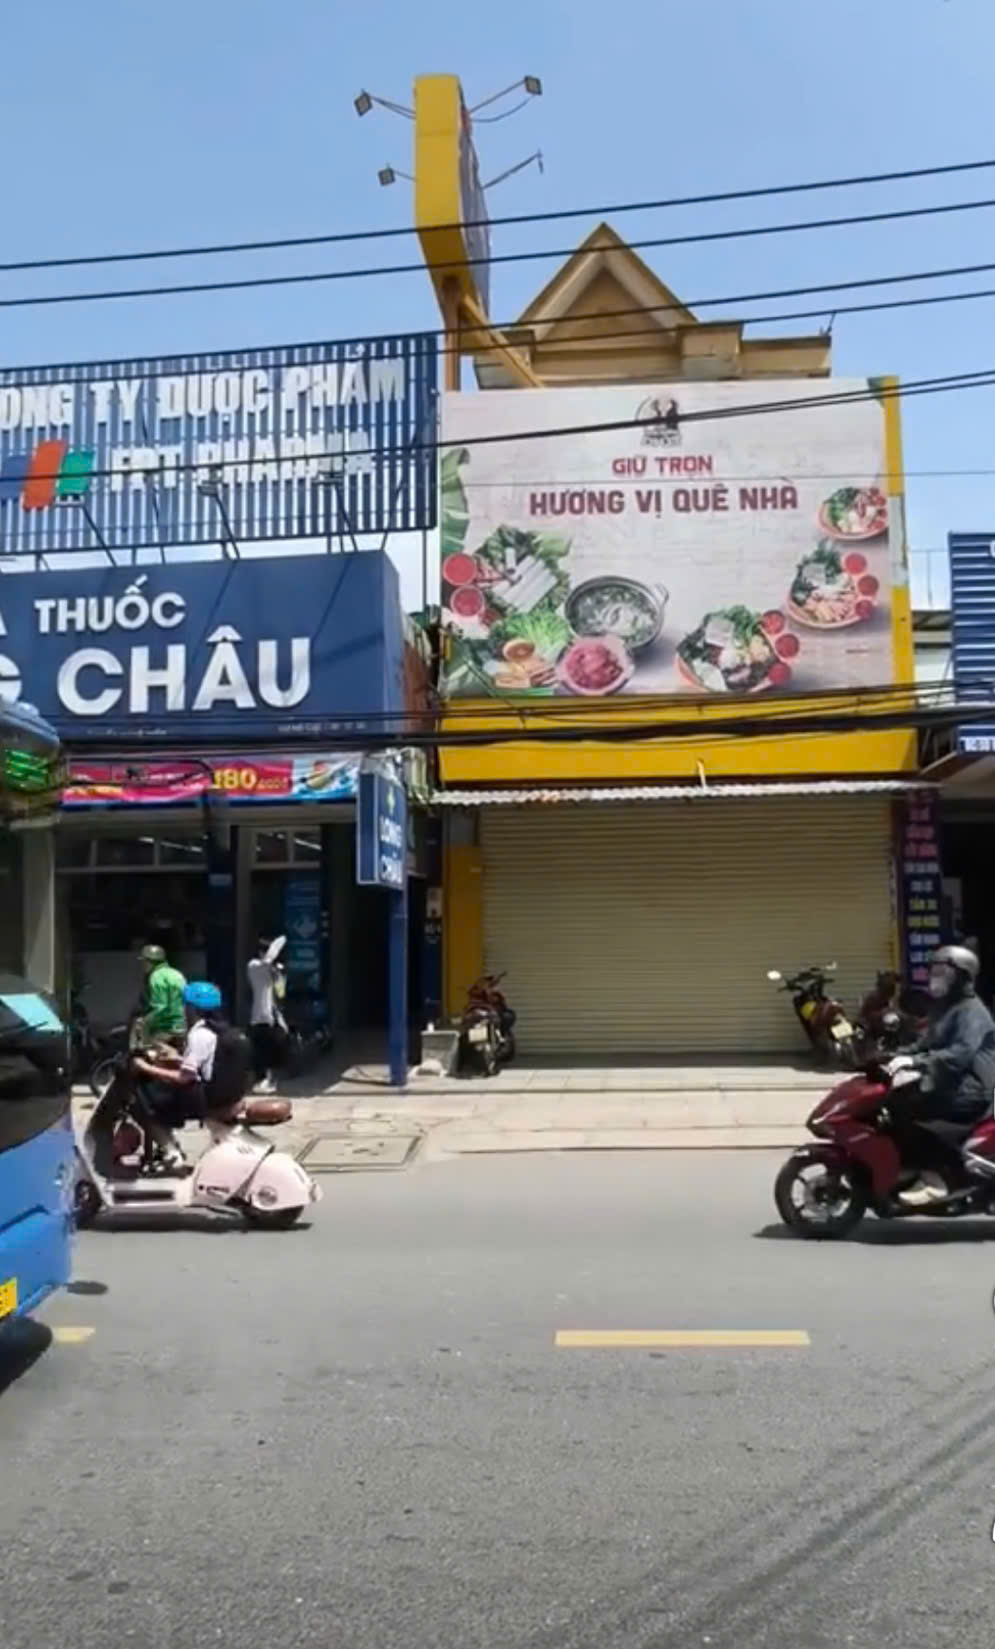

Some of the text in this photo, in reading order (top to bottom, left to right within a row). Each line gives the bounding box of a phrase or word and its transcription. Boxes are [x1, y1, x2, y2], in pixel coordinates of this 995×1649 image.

[89, 379, 142, 425] TY
[111, 446, 183, 494] FRT
[655, 455, 713, 481] TRỌN
[530, 476, 798, 519] HƯƠNG VỊ QUÊ NHÀ
[34, 574, 186, 634] THUỐC
[56, 624, 311, 716] CHÂU
